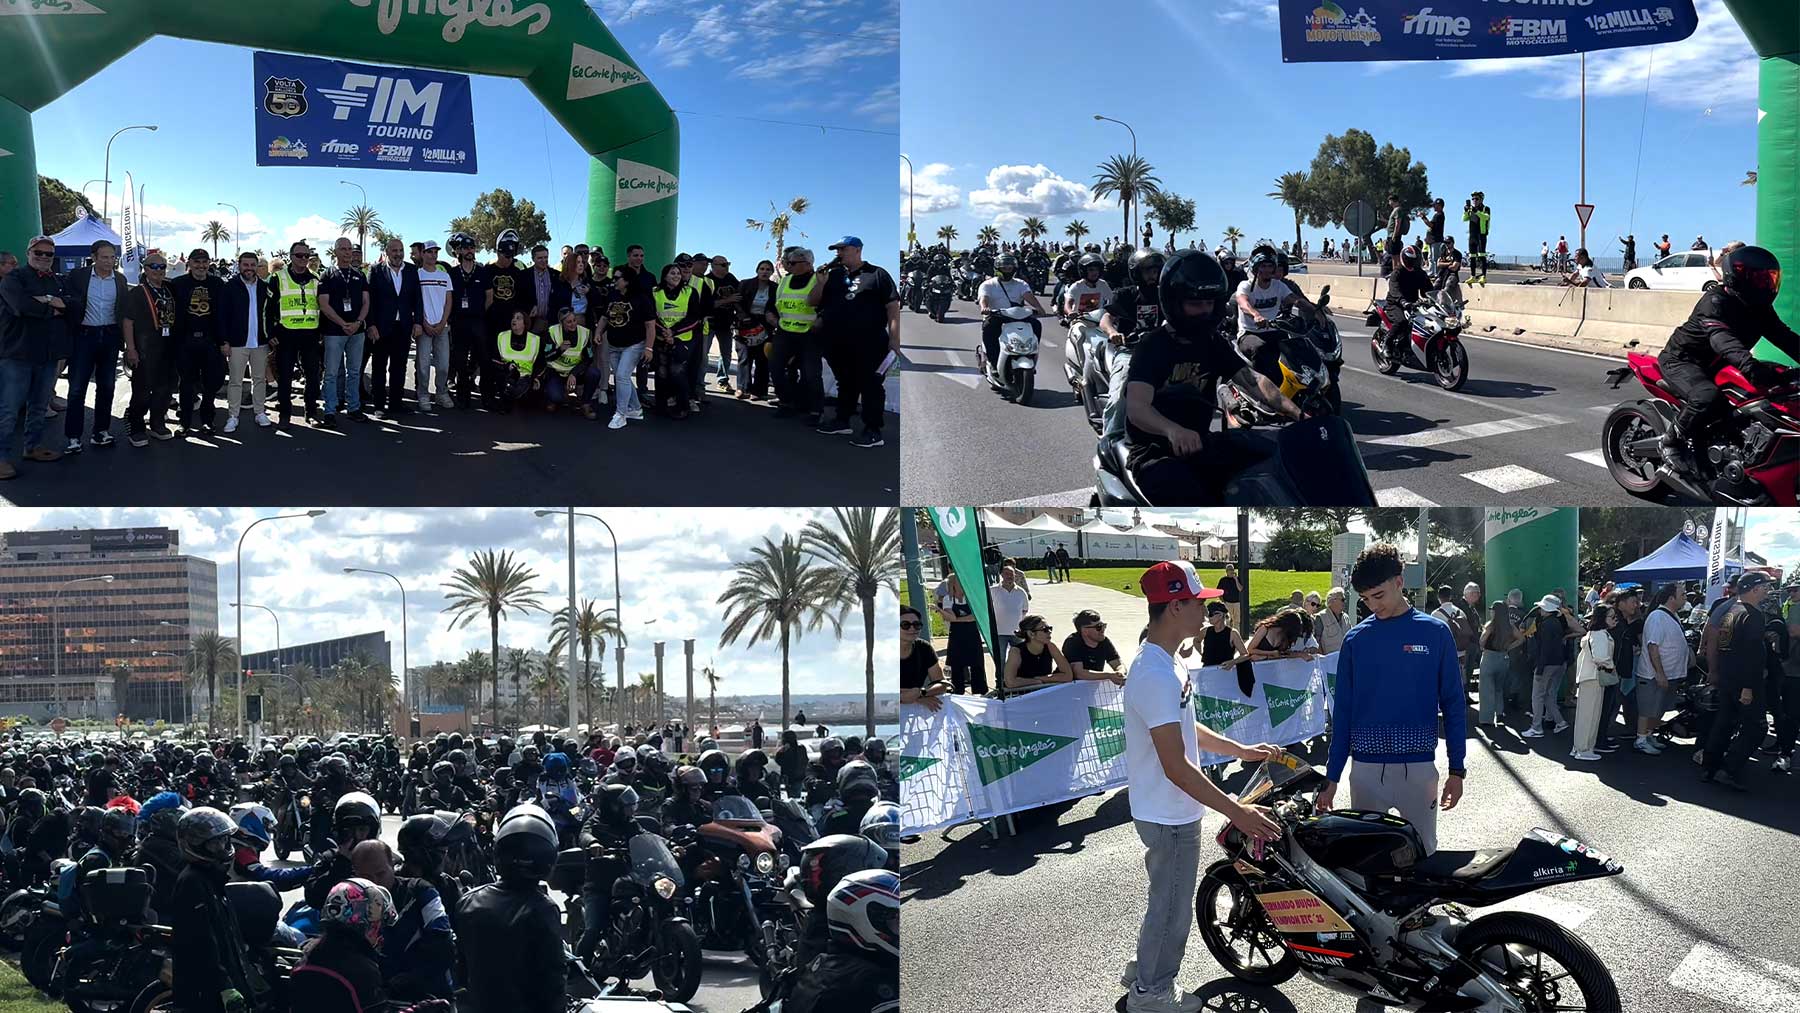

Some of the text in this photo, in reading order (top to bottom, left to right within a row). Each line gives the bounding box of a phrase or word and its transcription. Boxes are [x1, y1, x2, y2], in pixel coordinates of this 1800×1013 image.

[1402, 8, 1471, 36] rfme
[1506, 18, 1567, 37] FBM
[1305, 29, 1381, 42] MOTOTURISMO
[572, 64, 641, 83] El Corte Inglés
[274, 80, 297, 88] VOLTA
[316, 73, 443, 126] FIM
[367, 125, 433, 140] TOURING
[379, 144, 414, 157] FBM
[618, 177, 629, 189] El
[630, 177, 656, 189] Corte
[1499, 506, 1538, 524] Inglés
[976, 738, 1056, 759] El Corte Inglés
[1533, 867, 1564, 878] alkiria
